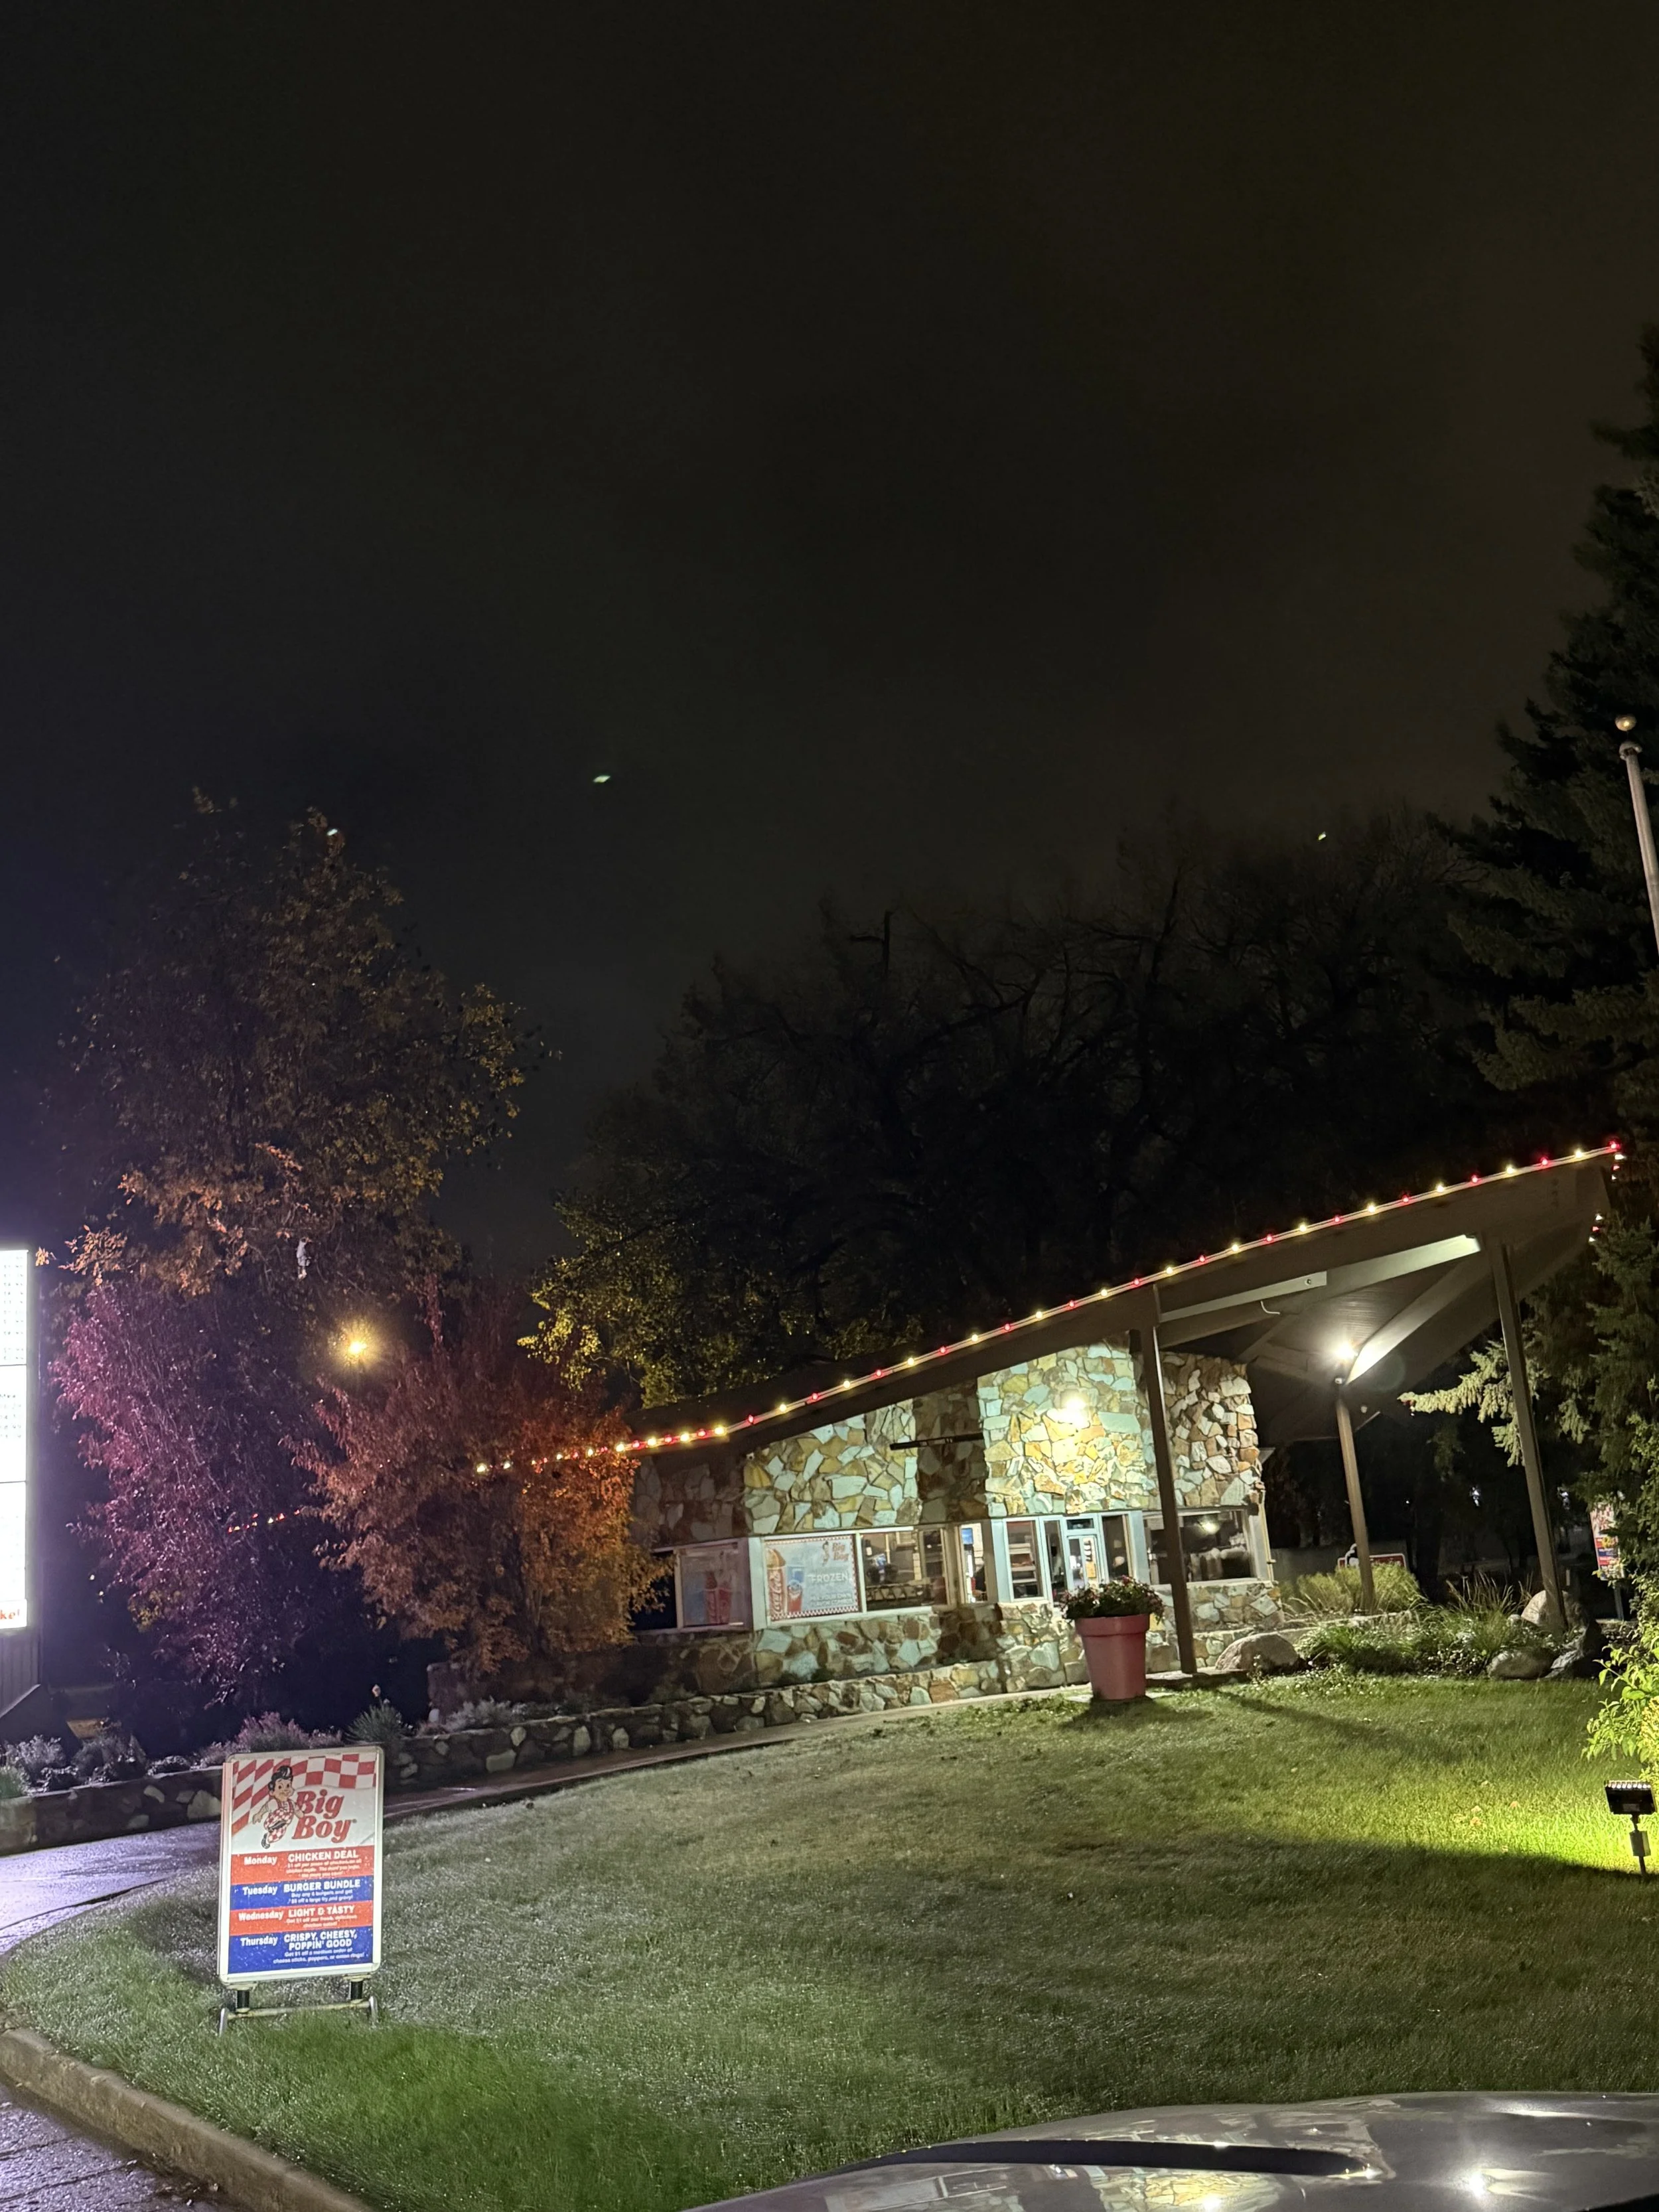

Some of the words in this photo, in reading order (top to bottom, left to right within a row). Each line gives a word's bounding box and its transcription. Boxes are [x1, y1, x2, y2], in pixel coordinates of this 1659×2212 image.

[810, 1570, 848, 1583] FROZEN
[296, 1789, 344, 1819] Big
[291, 1815, 352, 1844] Boy
[244, 1856, 277, 1866] Monday
[287, 1852, 331, 1862] CHICKEN
[333, 1850, 358, 1860] DEAL
[242, 1885, 278, 1895] Tuesday
[283, 1882, 322, 1893] BURGER
[324, 1880, 361, 1890] BUNDLE
[238, 1911, 283, 1921] Wednesday
[288, 1908, 315, 1917] LIGHT
[317, 1907, 325, 1916] &
[327, 1905, 355, 1915] TASTY
[240, 1935, 278, 1947] Thursday
[283, 1933, 318, 1943] CRISPY,
[320, 1929, 357, 1941] CHEESY,
[289, 1941, 325, 1951] POPPIN'
[326, 1939, 352, 1949] GOOD
